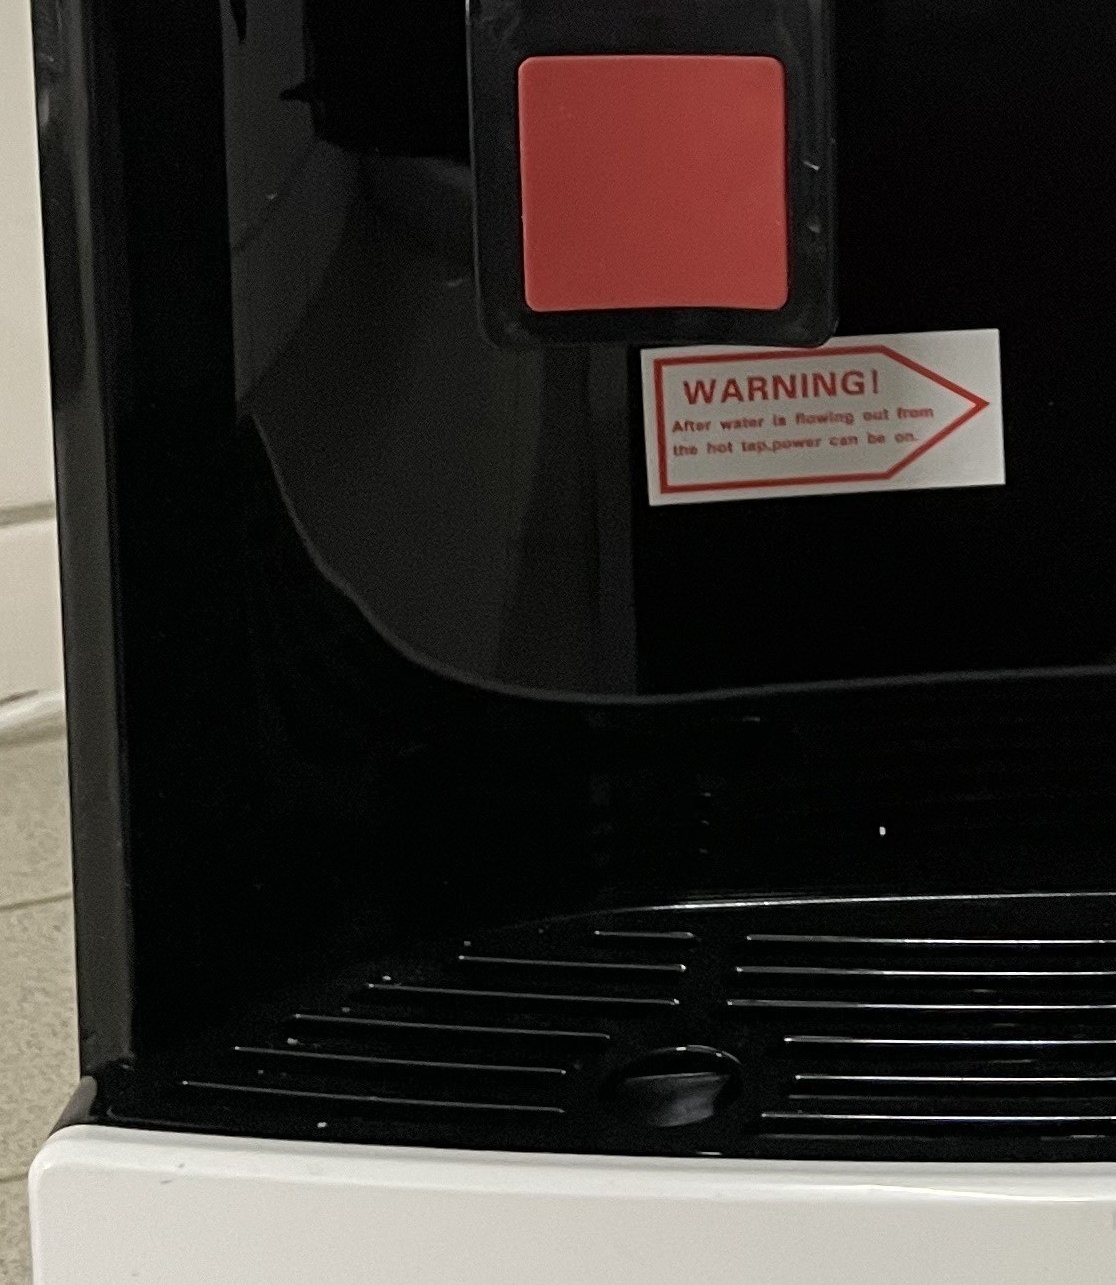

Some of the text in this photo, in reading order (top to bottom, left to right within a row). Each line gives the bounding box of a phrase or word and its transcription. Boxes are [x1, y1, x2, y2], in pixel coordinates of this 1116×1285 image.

[683, 369, 879, 405] WARNING!
[672, 407, 934, 433] After water is flowing out from
[673, 443, 698, 456] the
[707, 442, 733, 454] hot
[829, 434, 858, 446] can
[867, 432, 886, 444] be
